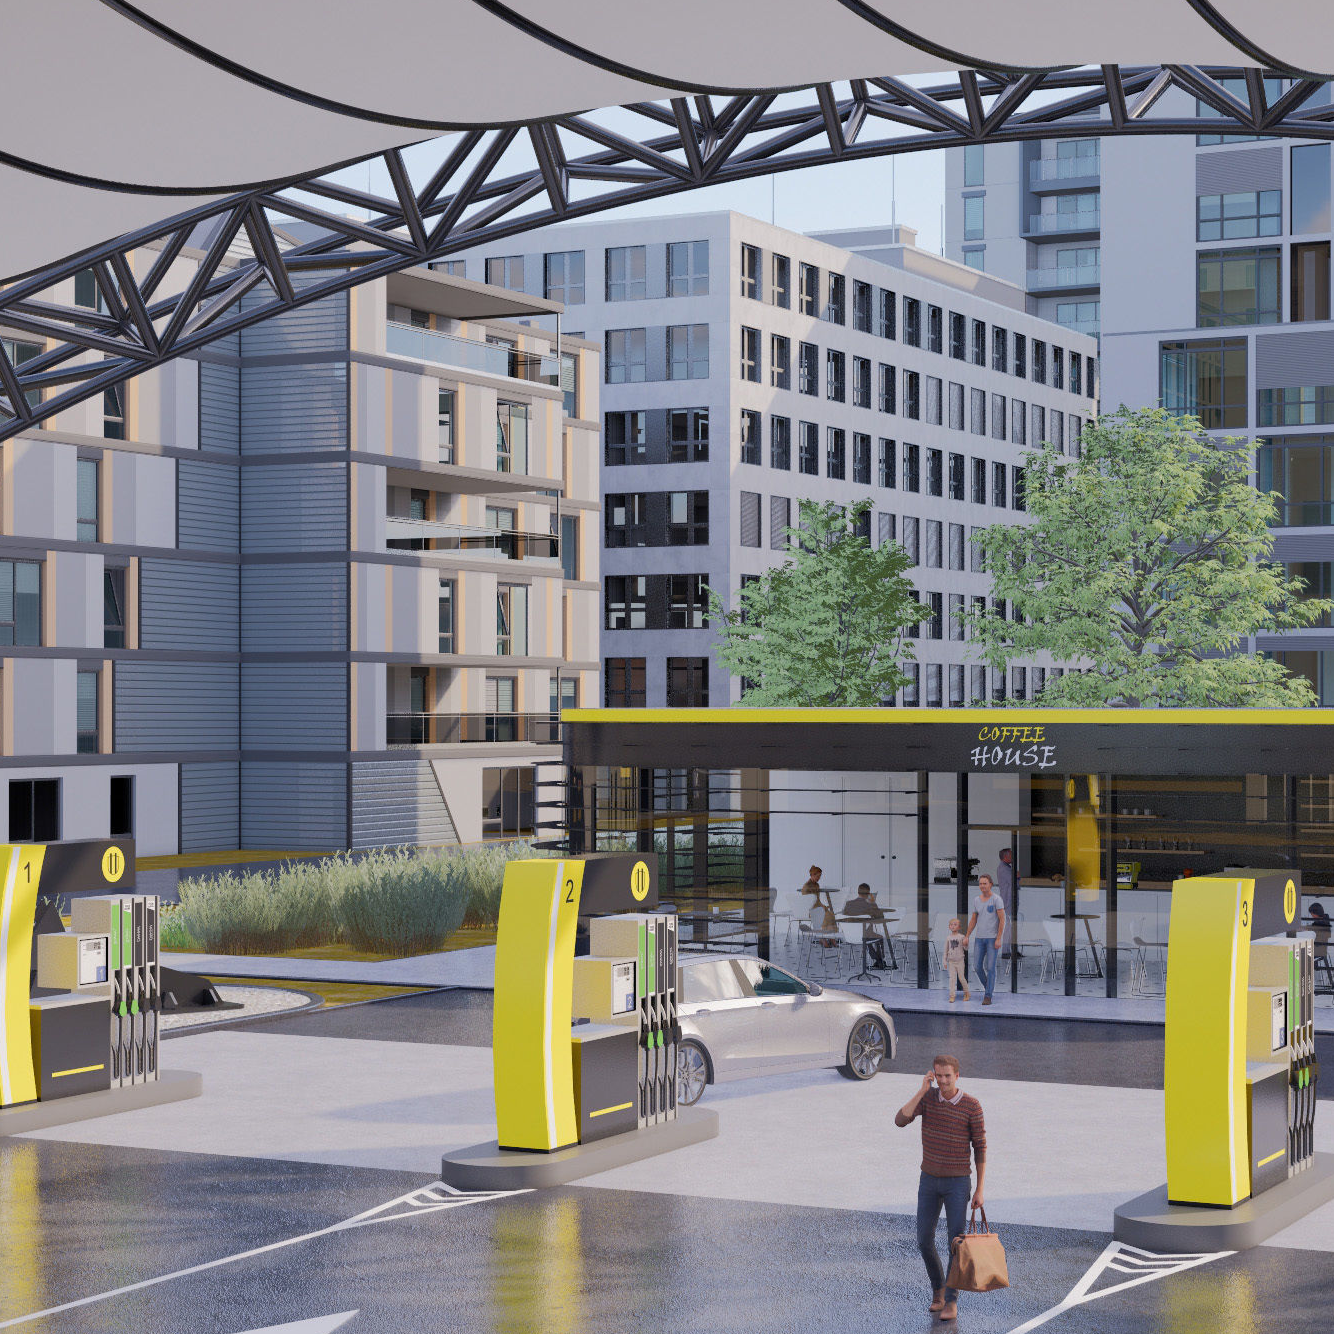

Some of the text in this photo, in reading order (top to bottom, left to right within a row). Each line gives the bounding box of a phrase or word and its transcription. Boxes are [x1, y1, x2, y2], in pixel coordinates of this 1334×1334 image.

[978, 726, 1046, 744] COFFEE
[970, 745, 1057, 769] HOUSE
[24, 861, 31, 883] 1
[566, 879, 574, 903] 2
[1243, 900, 1249, 927] 3
